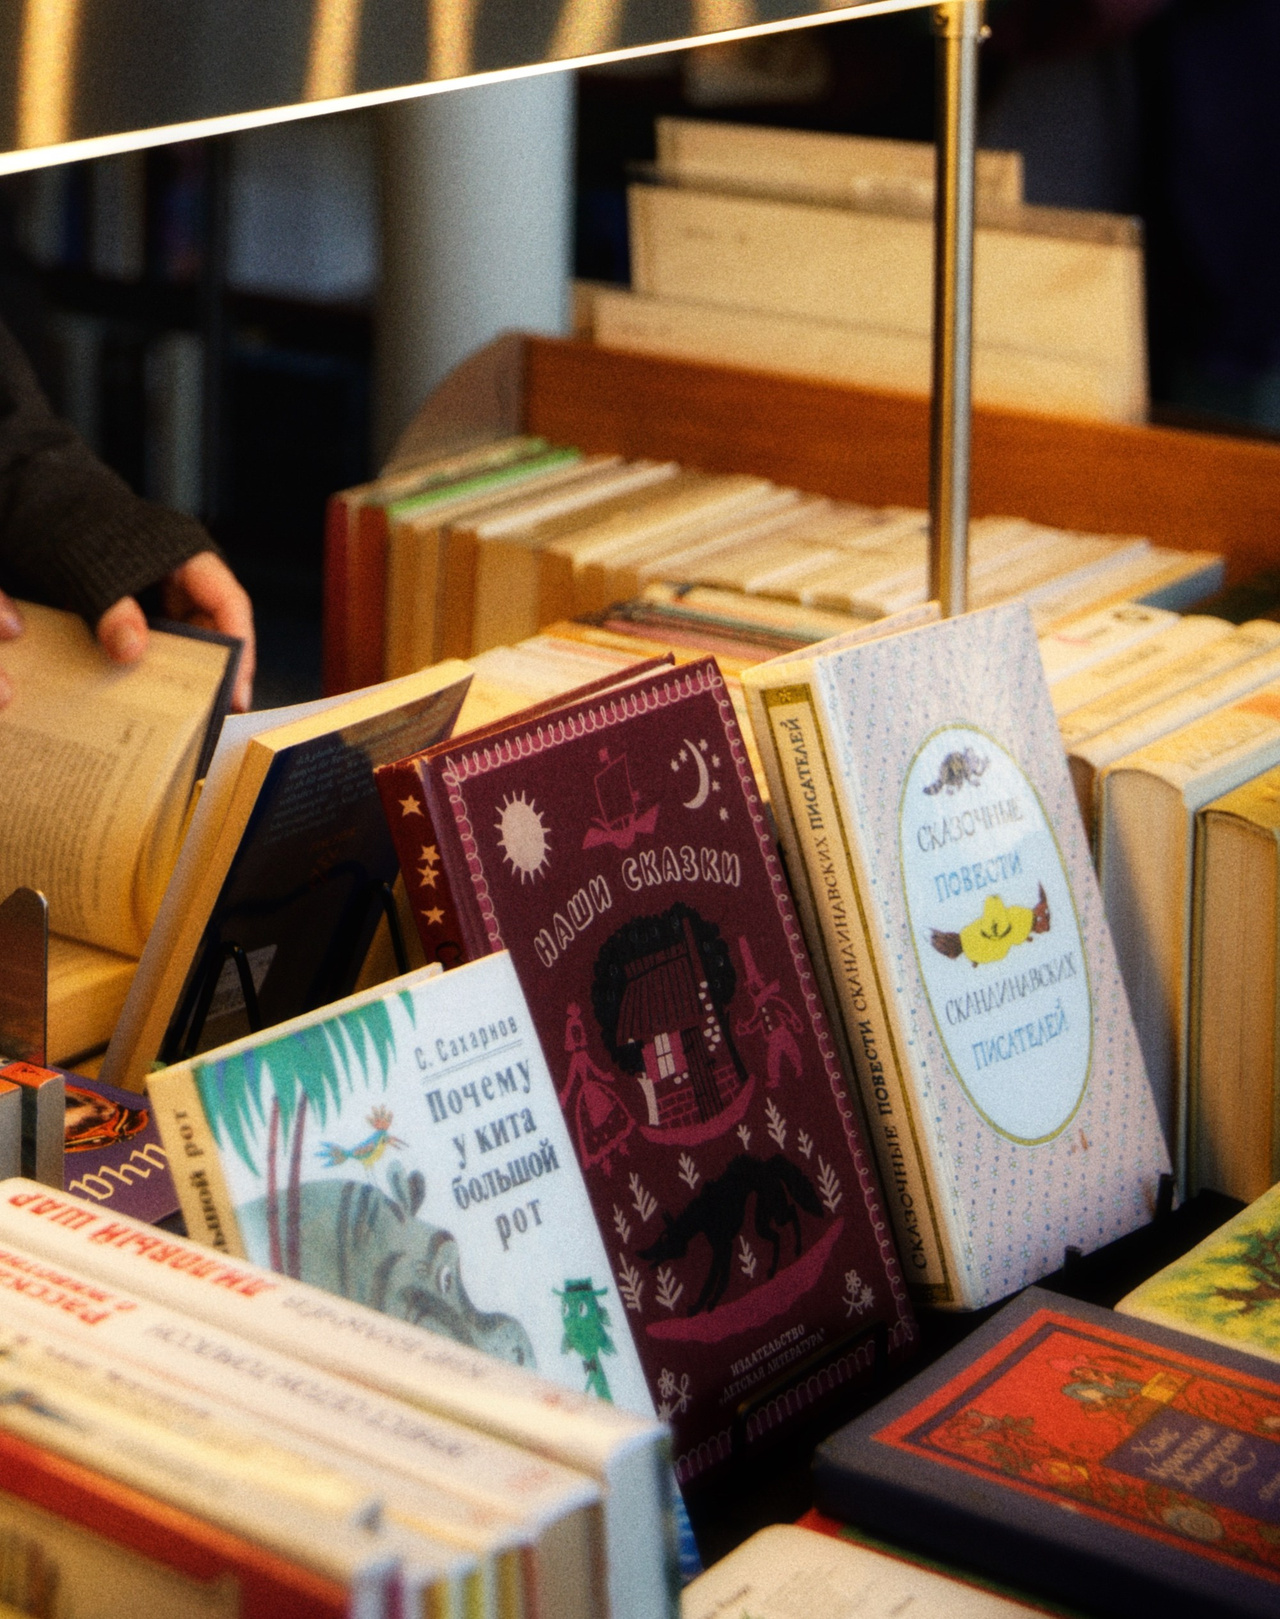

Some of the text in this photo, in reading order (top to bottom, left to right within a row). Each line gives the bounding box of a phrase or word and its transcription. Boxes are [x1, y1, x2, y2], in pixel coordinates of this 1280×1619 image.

[916, 798, 1025, 852] СКАЗОЧНЫЕ
[533, 845, 741, 968] НАШИ СКАЗКИ
[934, 851, 1024, 902] ПОВЕСТИ
[780, 716, 927, 1269] СКАЗОЧНЫЕ ПОВЕСТИ СКАНДИНАВСКИХ ПИСАТЕЛЕЙ
[945, 952, 1078, 1026] СКАНДИНАВСКИХ
[414, 1015, 519, 1071] С. Сахарнов
[972, 998, 1069, 1071] ПИСАТЕЛЕЙ
[424, 1058, 534, 1124] Почему
[452, 1106, 538, 1171] у кита
[451, 1137, 560, 1211] большой
[7, 1192, 279, 1298] ЛИЛОВЫЙ ШАР
[495, 1199, 544, 1252] рот
